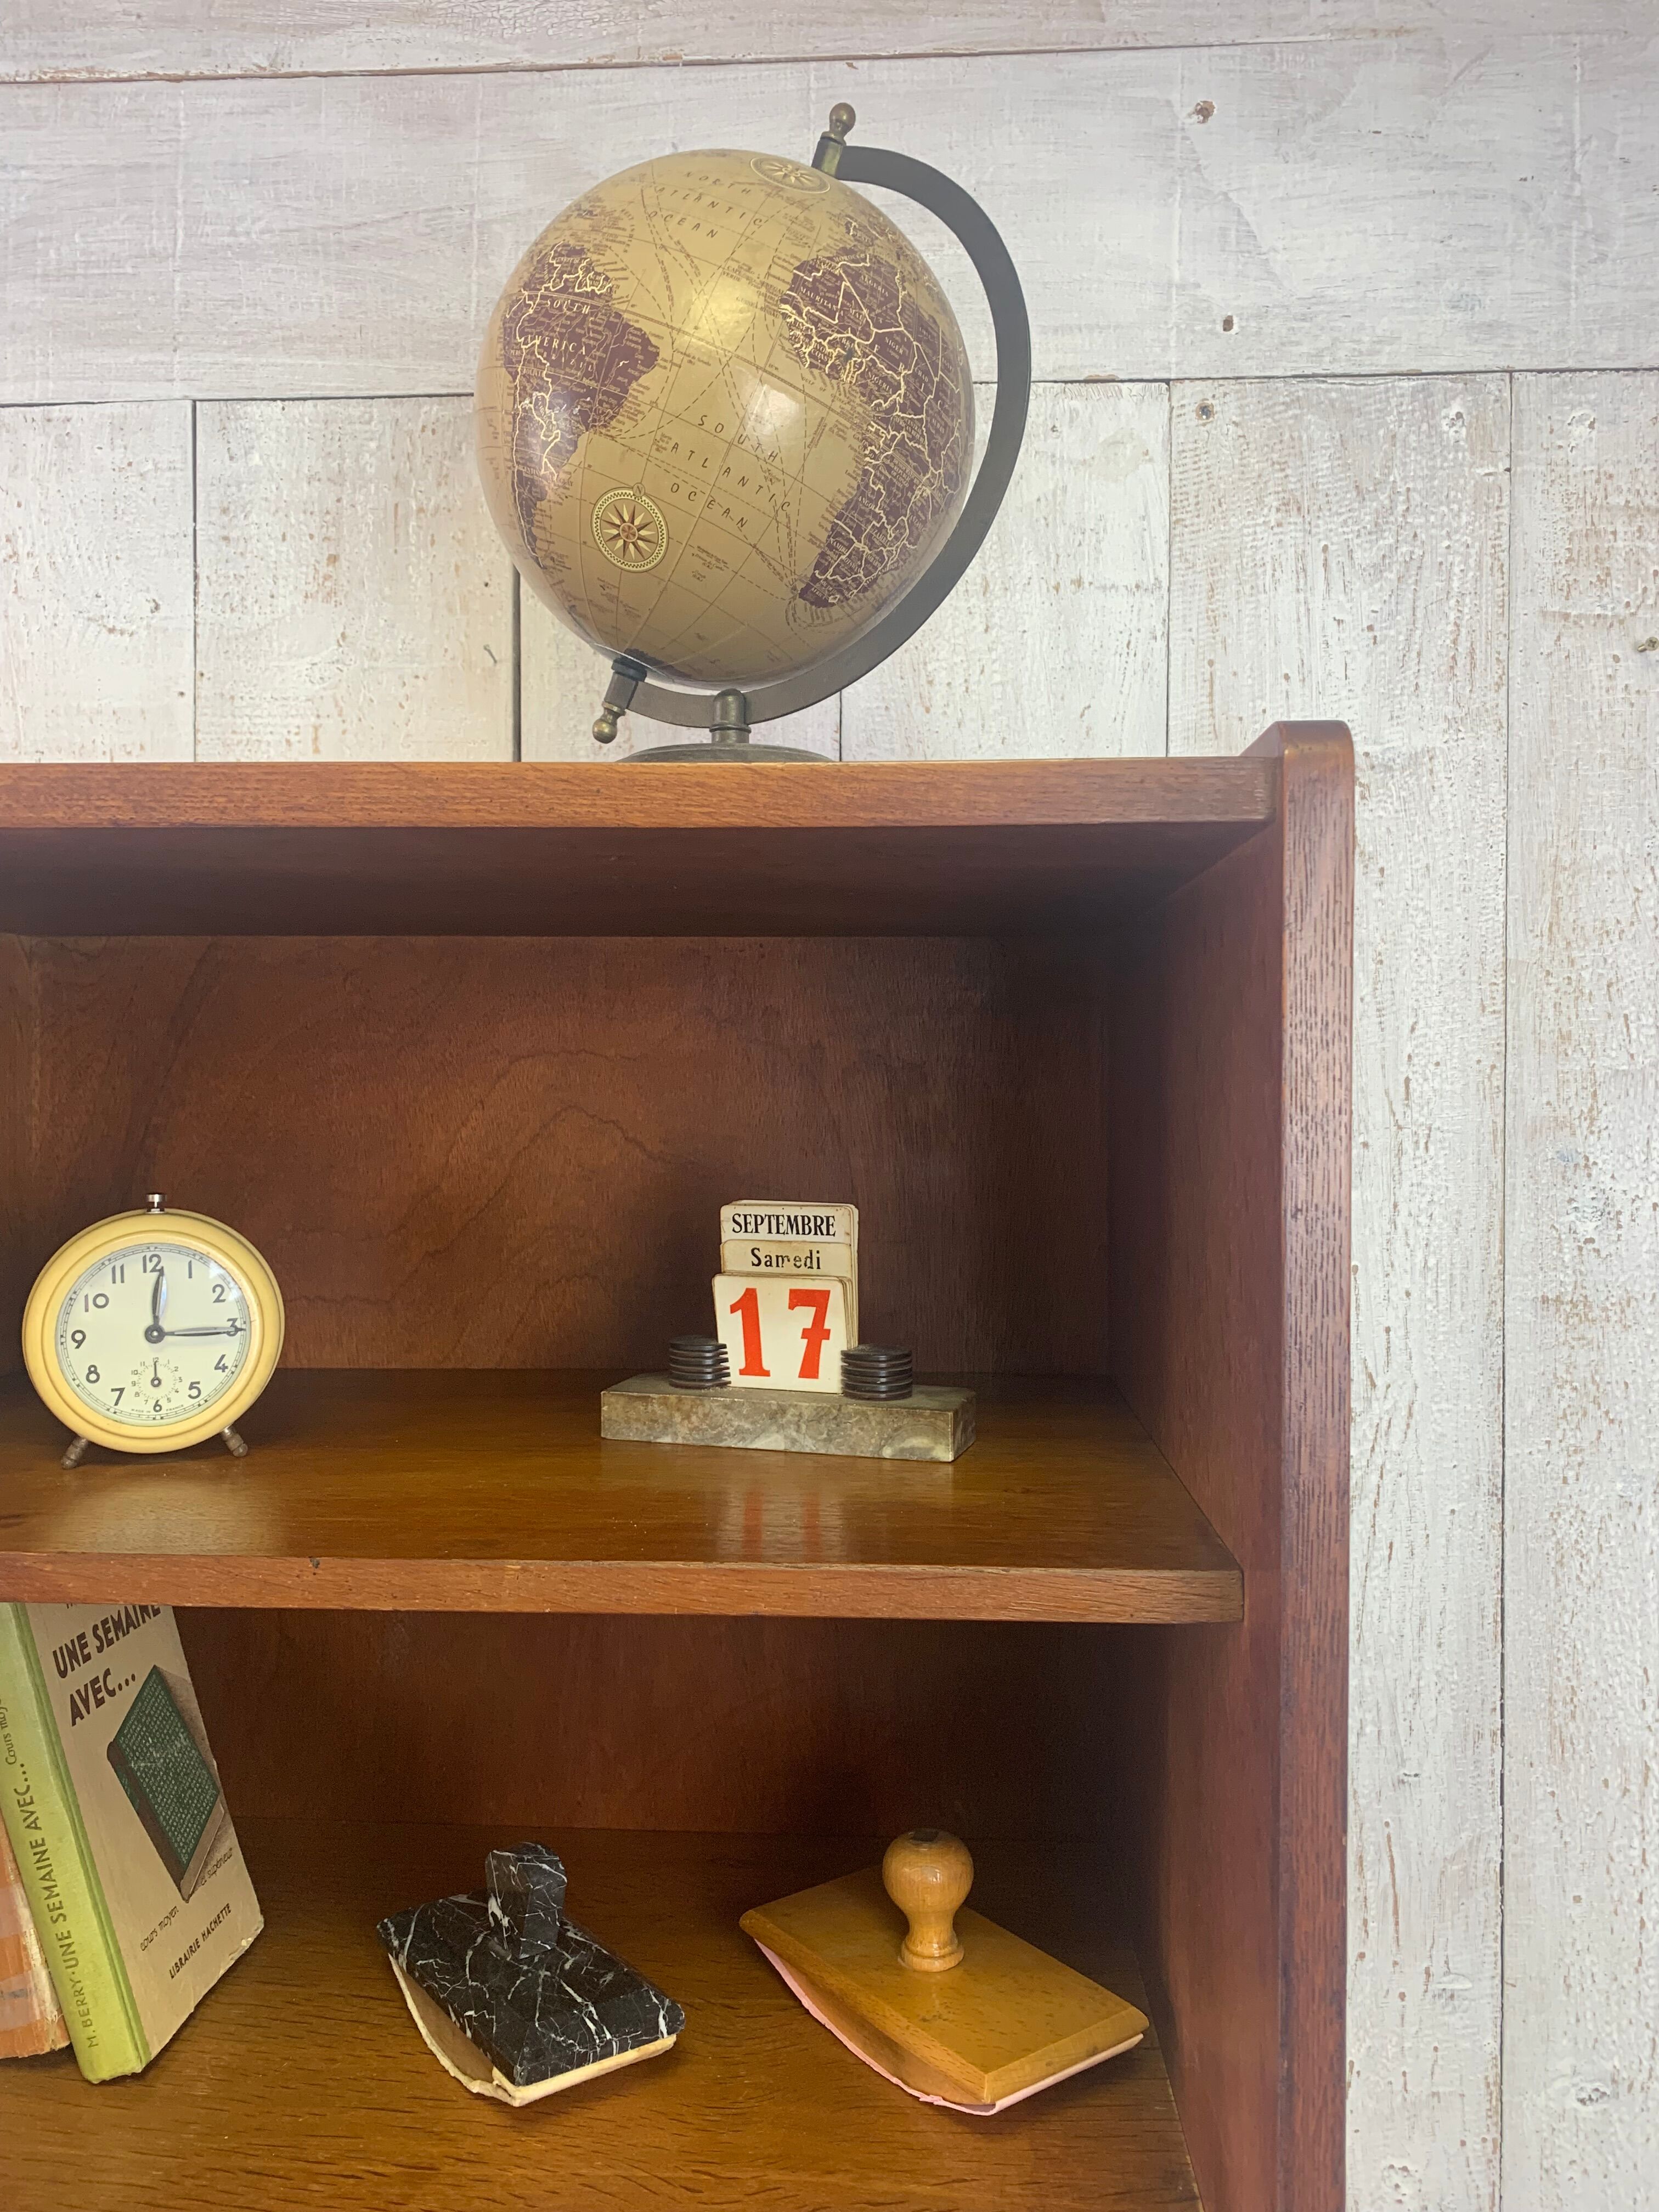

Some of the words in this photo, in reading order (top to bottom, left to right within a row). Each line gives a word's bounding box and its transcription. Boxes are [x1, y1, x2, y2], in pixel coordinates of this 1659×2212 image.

[686, 171, 751, 194] NORTH
[657, 187, 763, 226] ATLANTIC
[649, 210, 719, 238] OCEAN
[697, 414, 778, 462] SOUTH
[670, 442, 791, 512] ATLANTIC
[670, 482, 748, 528] OCEAN
[732, 1213, 837, 1237] SEPTEMBRE
[143, 1254, 163, 1273] 12
[188, 1260, 193, 1279] 1
[751, 1247, 822, 1269] Samedi
[111, 1263, 125, 1284] 11
[84, 1293, 110, 1313] 10
[212, 1284, 226, 1303] 2
[71, 1329, 87, 1350] 9
[225, 1318, 239, 1337] 3
[730, 1287, 832, 1380] 17
[86, 1364, 101, 1384] 8
[214, 1354, 229, 1373] 4
[111, 1387, 125, 1406] 7
[188, 1381, 202, 1400] 5
[153, 1400, 163, 1413] 6
[52, 1632, 92, 1679] UNE
[92, 1605, 161, 1654] SEMAINE
[70, 1667, 136, 1728] AVEC...
[3, 1733, 17, 1766] Cours
[13, 1763, 43, 1831] AVEC...
[29, 1837, 67, 1925] SEMAINE
[140, 1928, 158, 1951] cours
[158, 1905, 179, 1932] moyen
[55, 1929, 80, 1970] UNE
[169, 1938, 201, 1980] LIBRAIRIE
[201, 1902, 232, 1942] HACHETTE
